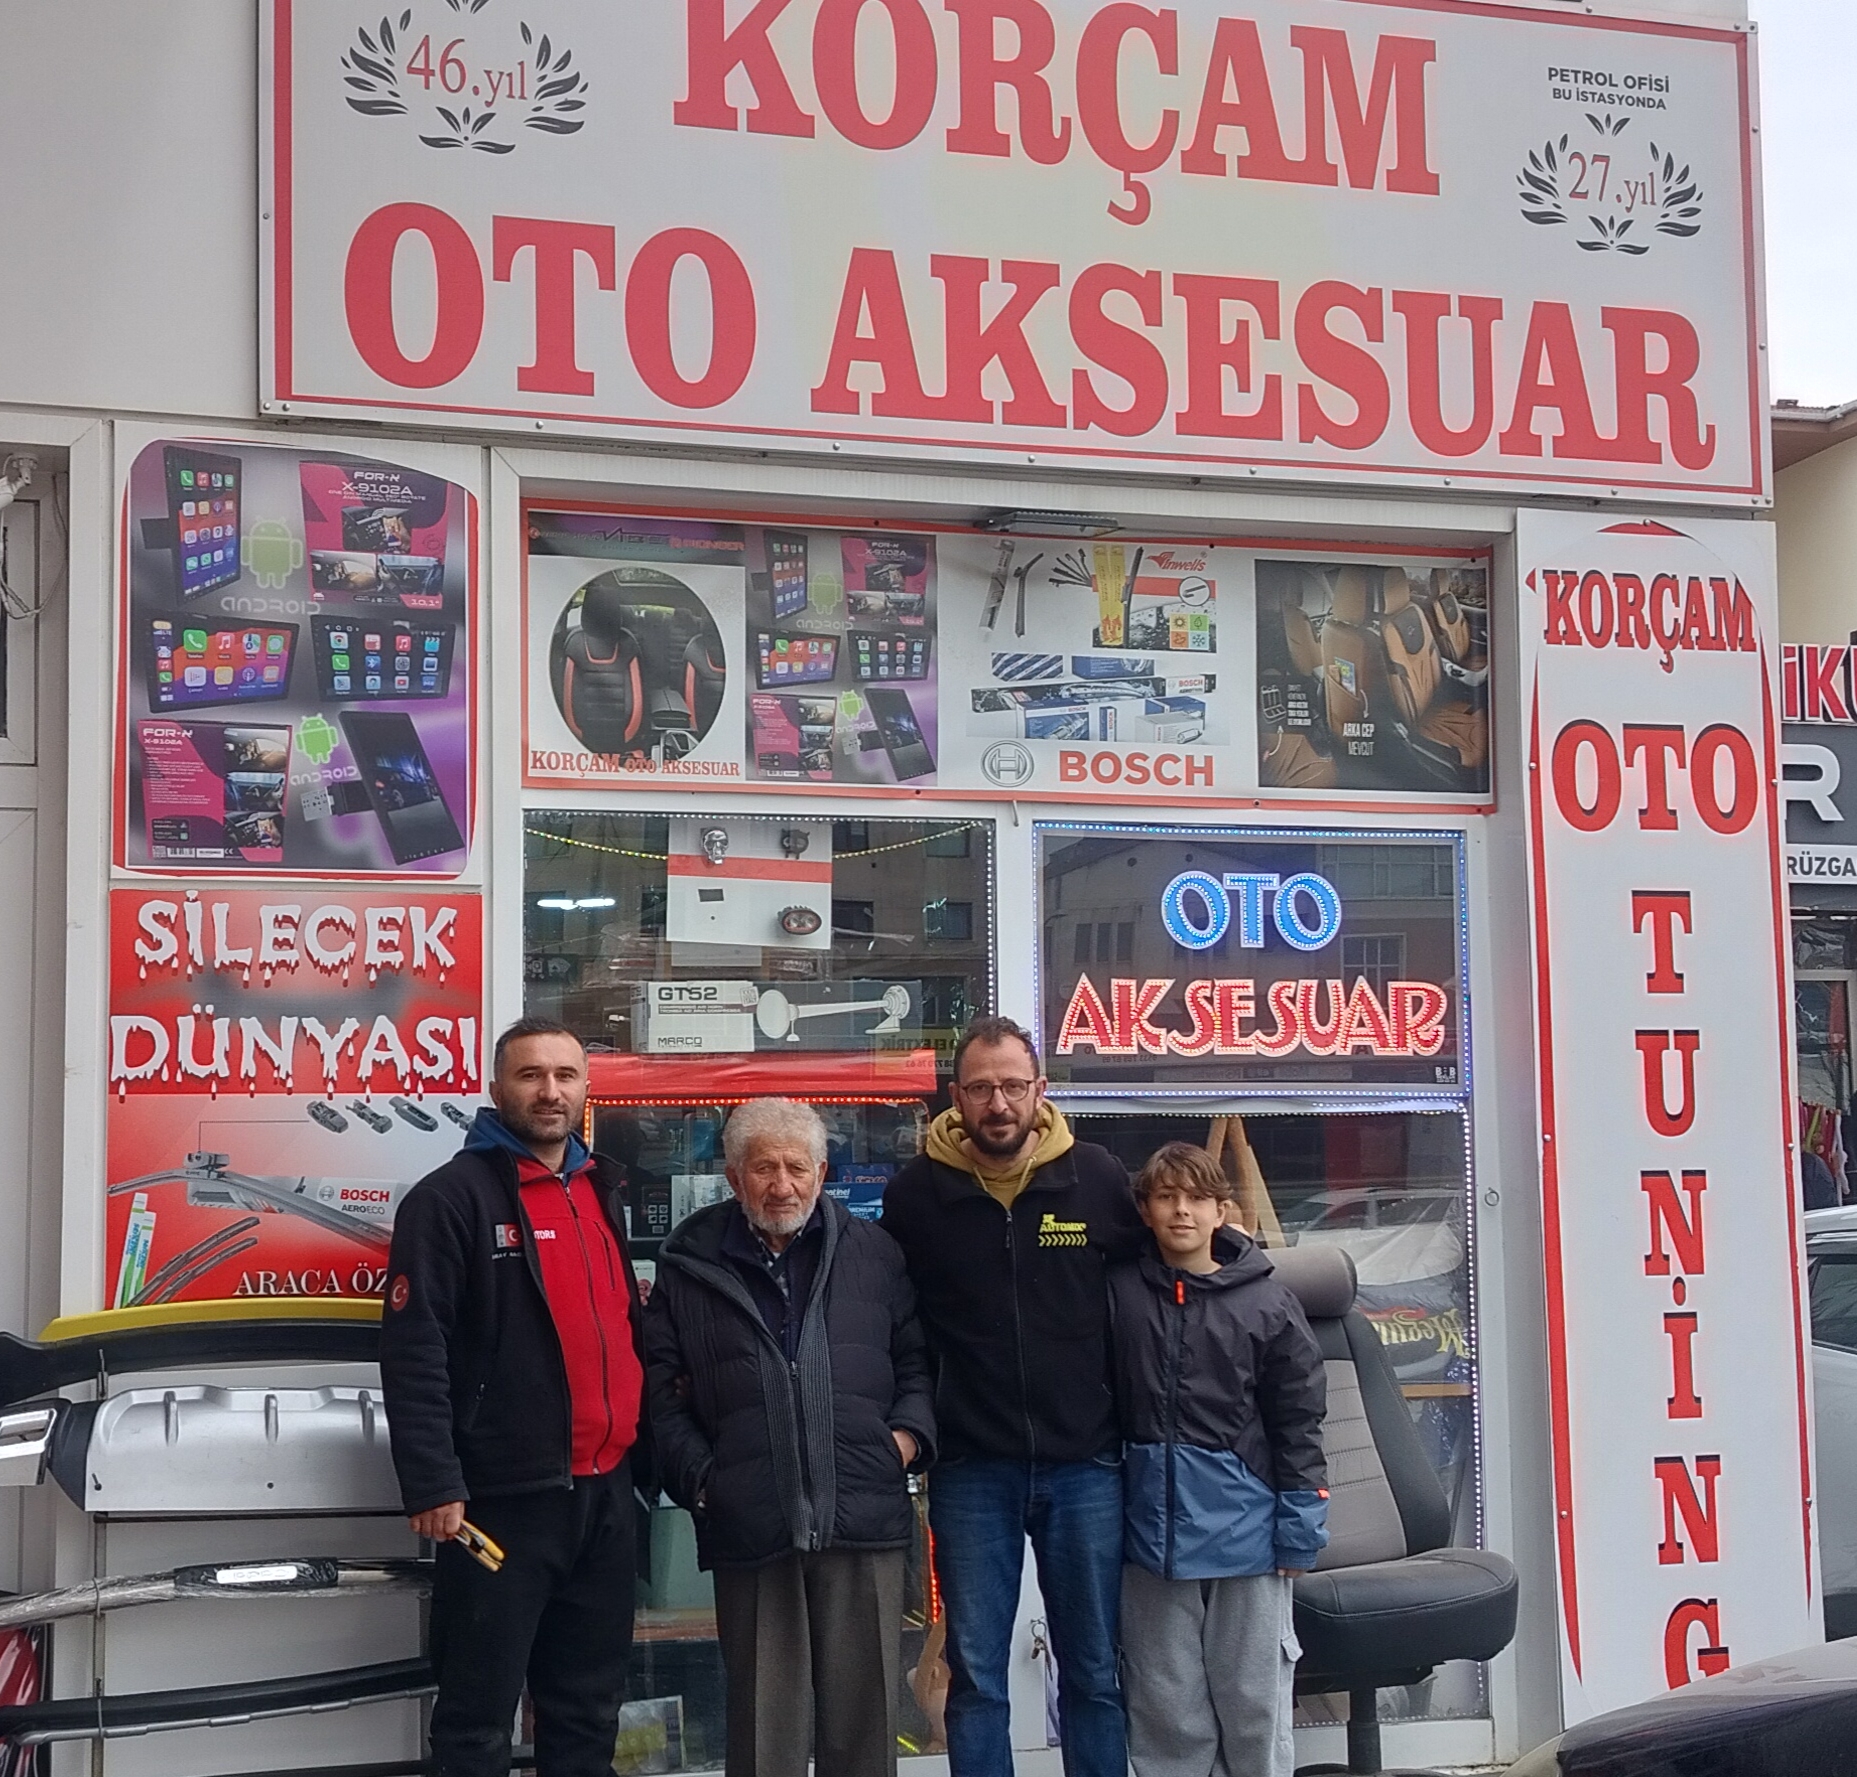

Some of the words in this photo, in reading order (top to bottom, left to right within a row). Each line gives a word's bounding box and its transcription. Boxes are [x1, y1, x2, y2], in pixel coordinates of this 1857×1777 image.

[406, 34, 528, 107] 46.yıl
[1547, 66, 1619, 88] PETROL
[1623, 72, 1670, 93] OFİSİ
[1552, 88, 1573, 101] BU
[1576, 87, 1667, 110] İSTASYONDA
[673, 0, 1440, 225] KORÇAM
[1567, 151, 1657, 213] 27.yıl
[344, 202, 757, 409] OTO
[811, 247, 1717, 470] AKSESUAR
[342, 481, 413, 496] X-9102A
[1542, 568, 1757, 674] KORÇAM
[1178, 676, 1204, 688] BOSCH
[1780, 642, 1857, 723] İK
[531, 750, 620, 778] KORÇAM
[624, 758, 657, 774] OTO
[660, 759, 740, 778] AKSESUAR
[1059, 749, 1215, 788] BOSCH
[1552, 719, 1758, 835] OTO
[134, 889, 458, 986] SİLECEK
[1161, 870, 1342, 951] OTO
[658, 986, 718, 1001] GT52
[1055, 972, 1448, 1058] AKSESUAR
[109, 1003, 478, 1101] DÜNYASI
[657, 1036, 703, 1045] MARCO
[340, 1187, 391, 1203] BOSCH
[341, 1203, 385, 1215] AEROECO
[232, 1268, 344, 1297] ARACA
[1631, 889, 1731, 1691] TUNİNG
